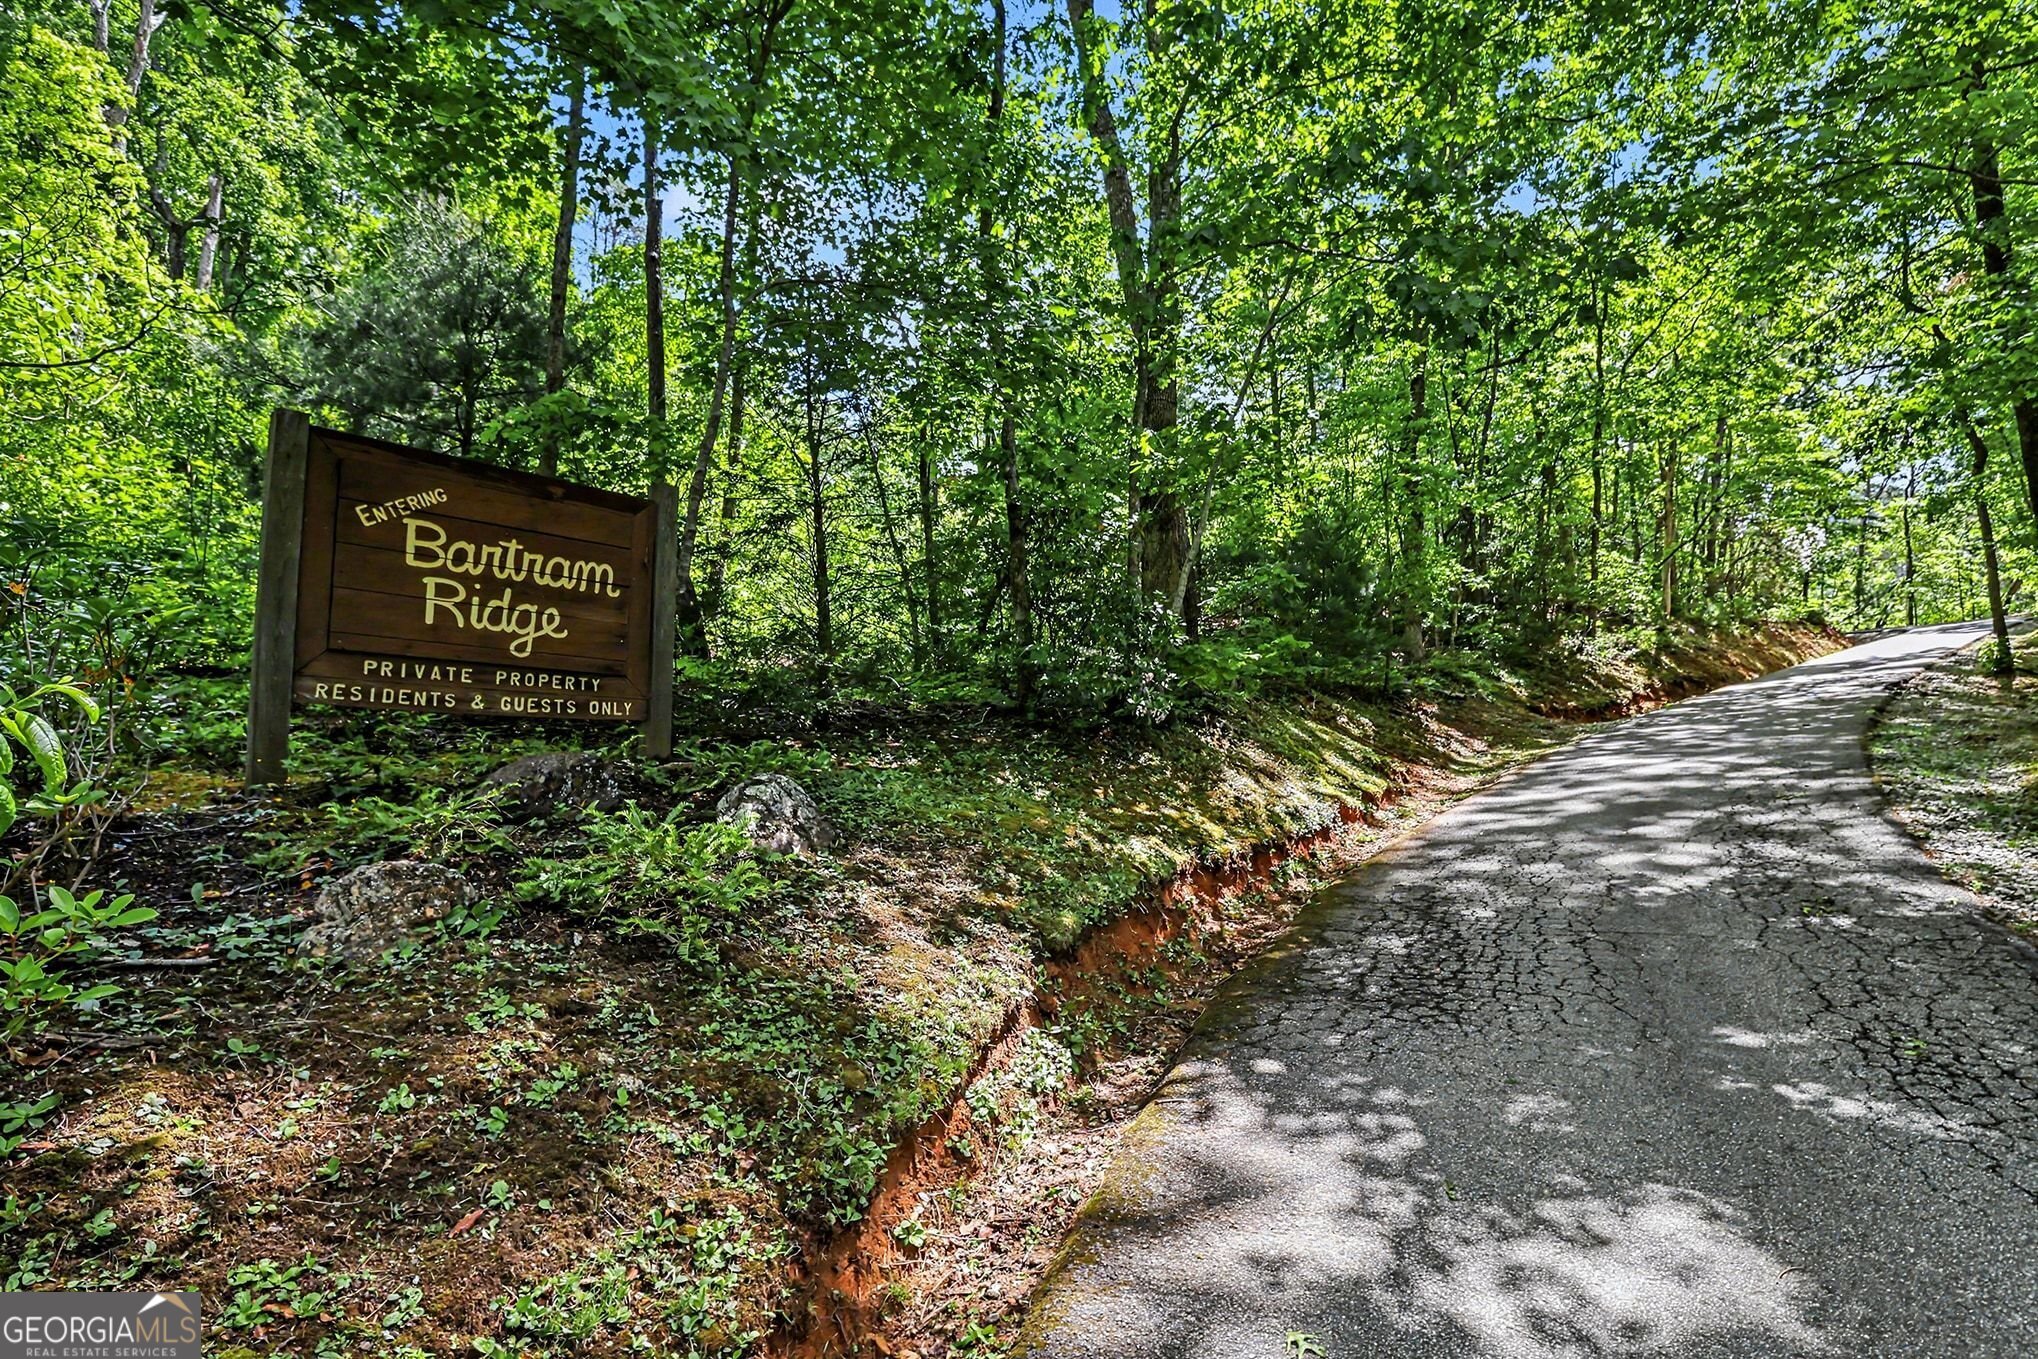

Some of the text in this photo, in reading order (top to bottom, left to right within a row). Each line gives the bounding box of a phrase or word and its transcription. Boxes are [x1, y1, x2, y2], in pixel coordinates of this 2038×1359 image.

[355, 488, 448, 528] ENTERING
[402, 517, 621, 598] Bartram
[421, 576, 568, 658] Ridge
[363, 660, 601, 692] PRIVATE PROPERTY
[315, 683, 632, 716] RESIDENTS & GUESTS ONLY
